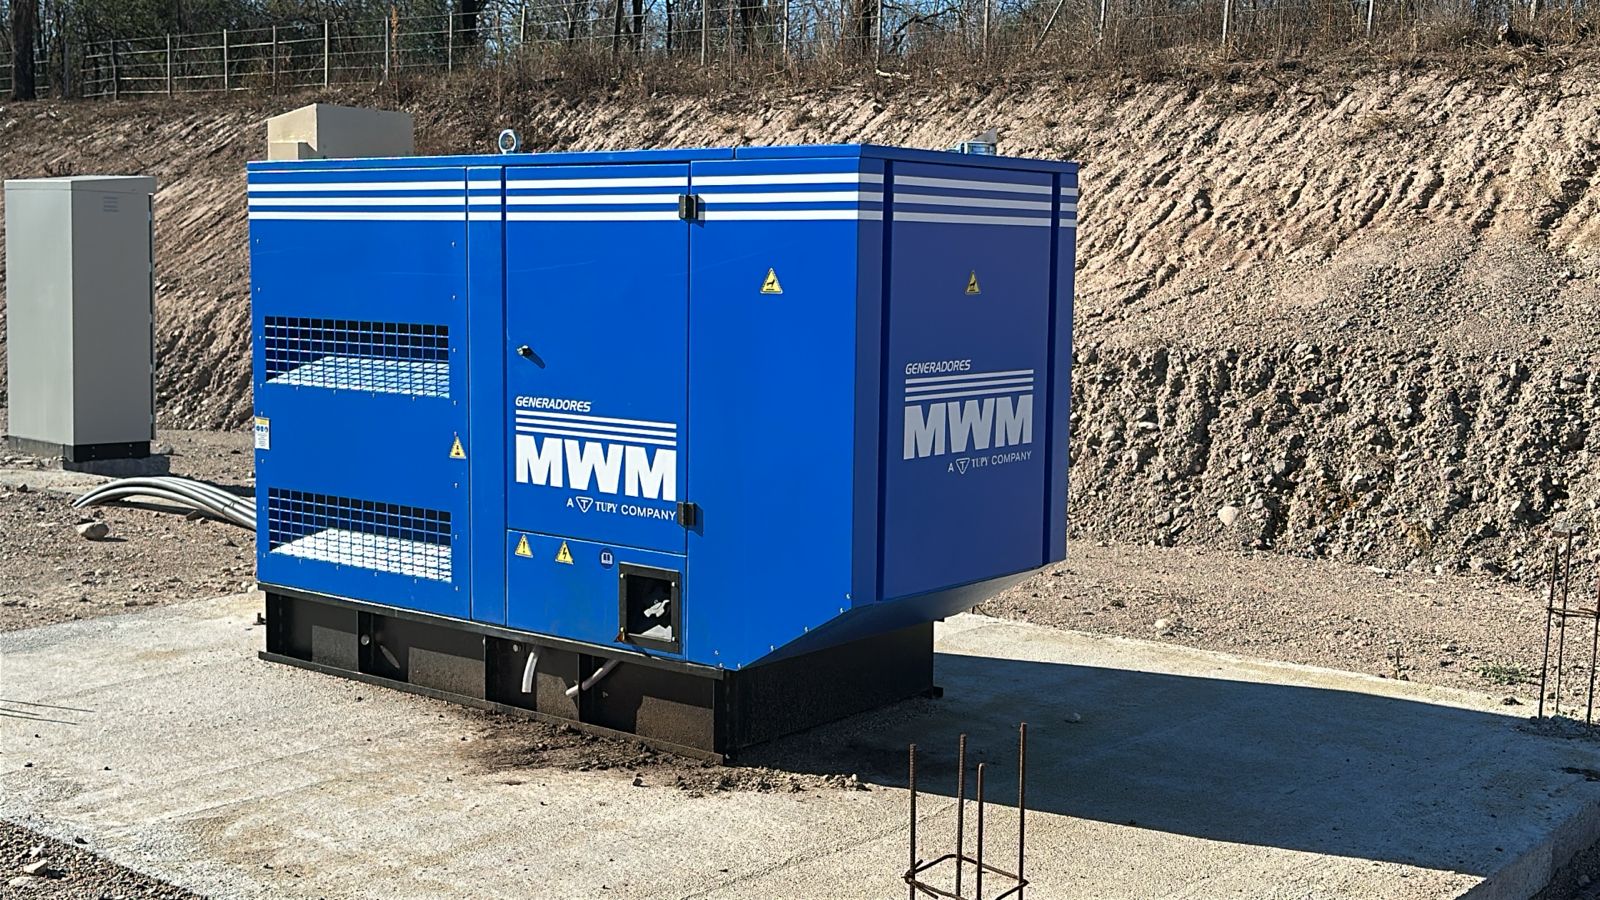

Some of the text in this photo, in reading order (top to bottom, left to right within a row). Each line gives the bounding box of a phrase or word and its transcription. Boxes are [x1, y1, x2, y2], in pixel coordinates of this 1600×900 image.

[905, 360, 972, 375] GENERADORES
[515, 396, 592, 413] GENERADORES
[903, 394, 1034, 460] MWM
[515, 434, 677, 502] MWM
[947, 462, 955, 473] A
[991, 451, 1032, 465] COMPANY
[566, 498, 575, 508] A
[595, 501, 618, 513] TUPY
[621, 504, 676, 521] COMPANY
